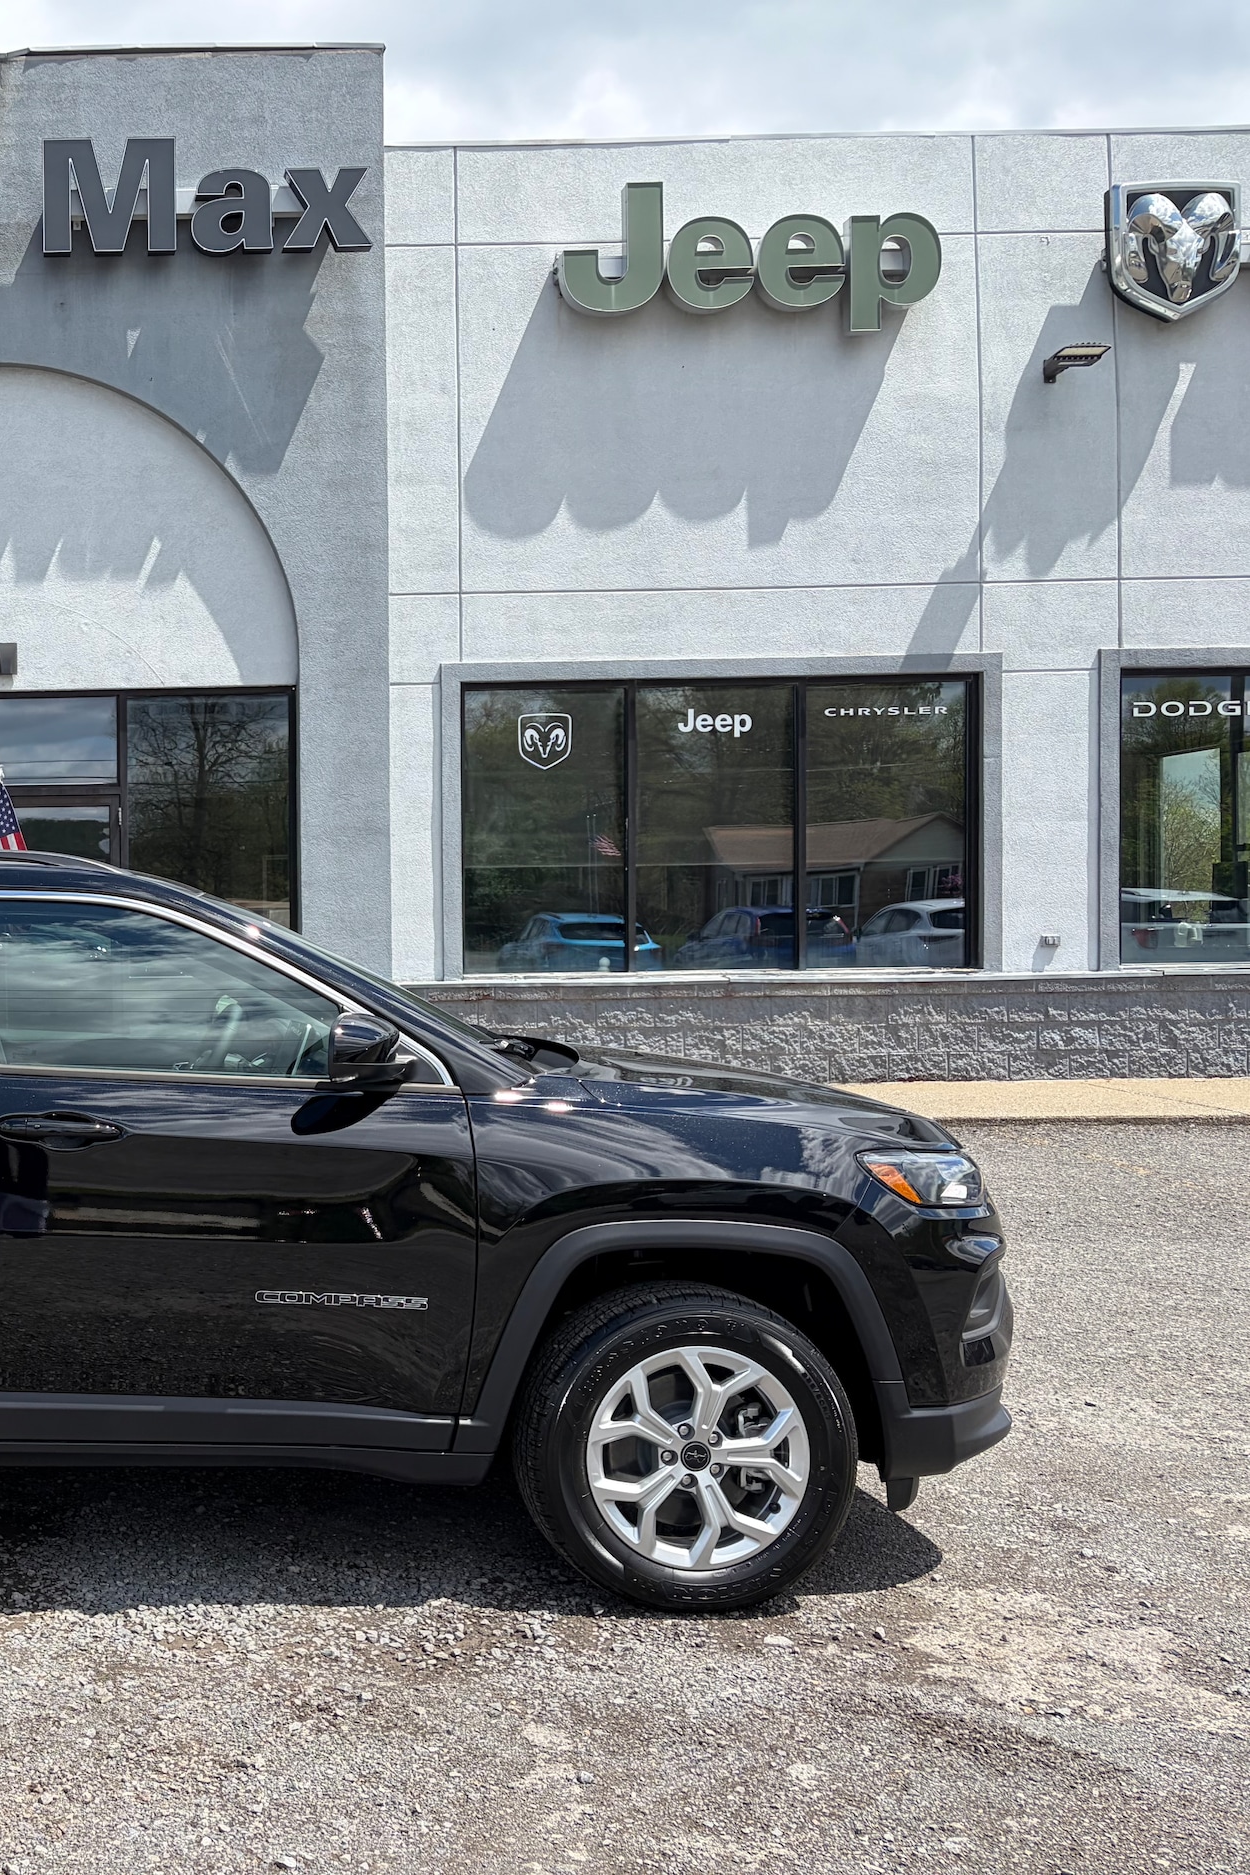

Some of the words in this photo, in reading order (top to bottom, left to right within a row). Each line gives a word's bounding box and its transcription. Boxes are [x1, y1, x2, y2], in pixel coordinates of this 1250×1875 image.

[42, 137, 373, 257] Max
[558, 181, 942, 333] Jeep
[824, 705, 949, 718] CHRYSLER
[1132, 700, 1250, 718] DODG
[678, 708, 753, 737] Jeep
[255, 1290, 429, 1310] COMPASS
